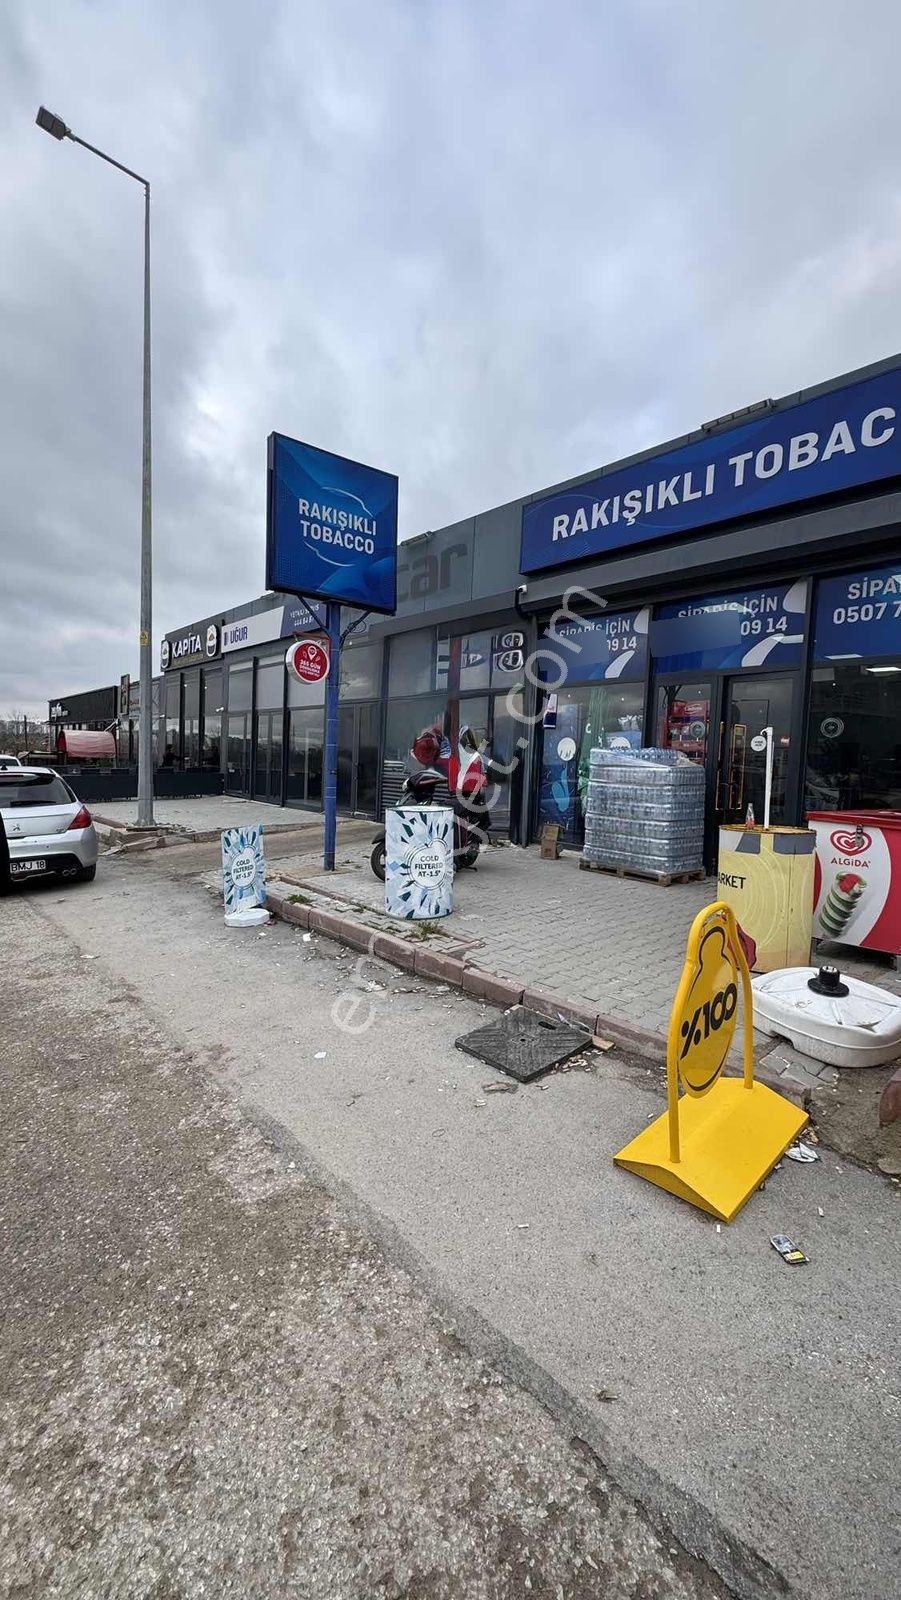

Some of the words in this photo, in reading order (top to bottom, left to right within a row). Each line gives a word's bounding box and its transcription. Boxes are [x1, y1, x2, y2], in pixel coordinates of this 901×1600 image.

[551, 464, 716, 541] RAKIŞIKLI
[728, 407, 896, 487] TOBAC
[299, 498, 377, 536] RAKIŞIKLI
[300, 520, 375, 555] TOBACCO
[847, 577, 901, 600] SİPA
[743, 594, 778, 618] İÇİN
[833, 602, 887, 625] 0507
[230, 626, 248, 644] UĞUR
[606, 618, 630, 637] İÇİN
[767, 616, 788, 633] 14
[171, 632, 202, 658] KAPİTA
[622, 636, 637, 650] 14
[36, 860, 45, 869] 18
[233, 864, 254, 873] FILTERED
[236, 858, 250, 867] COLD
[680, 983, 738, 1061] %100
